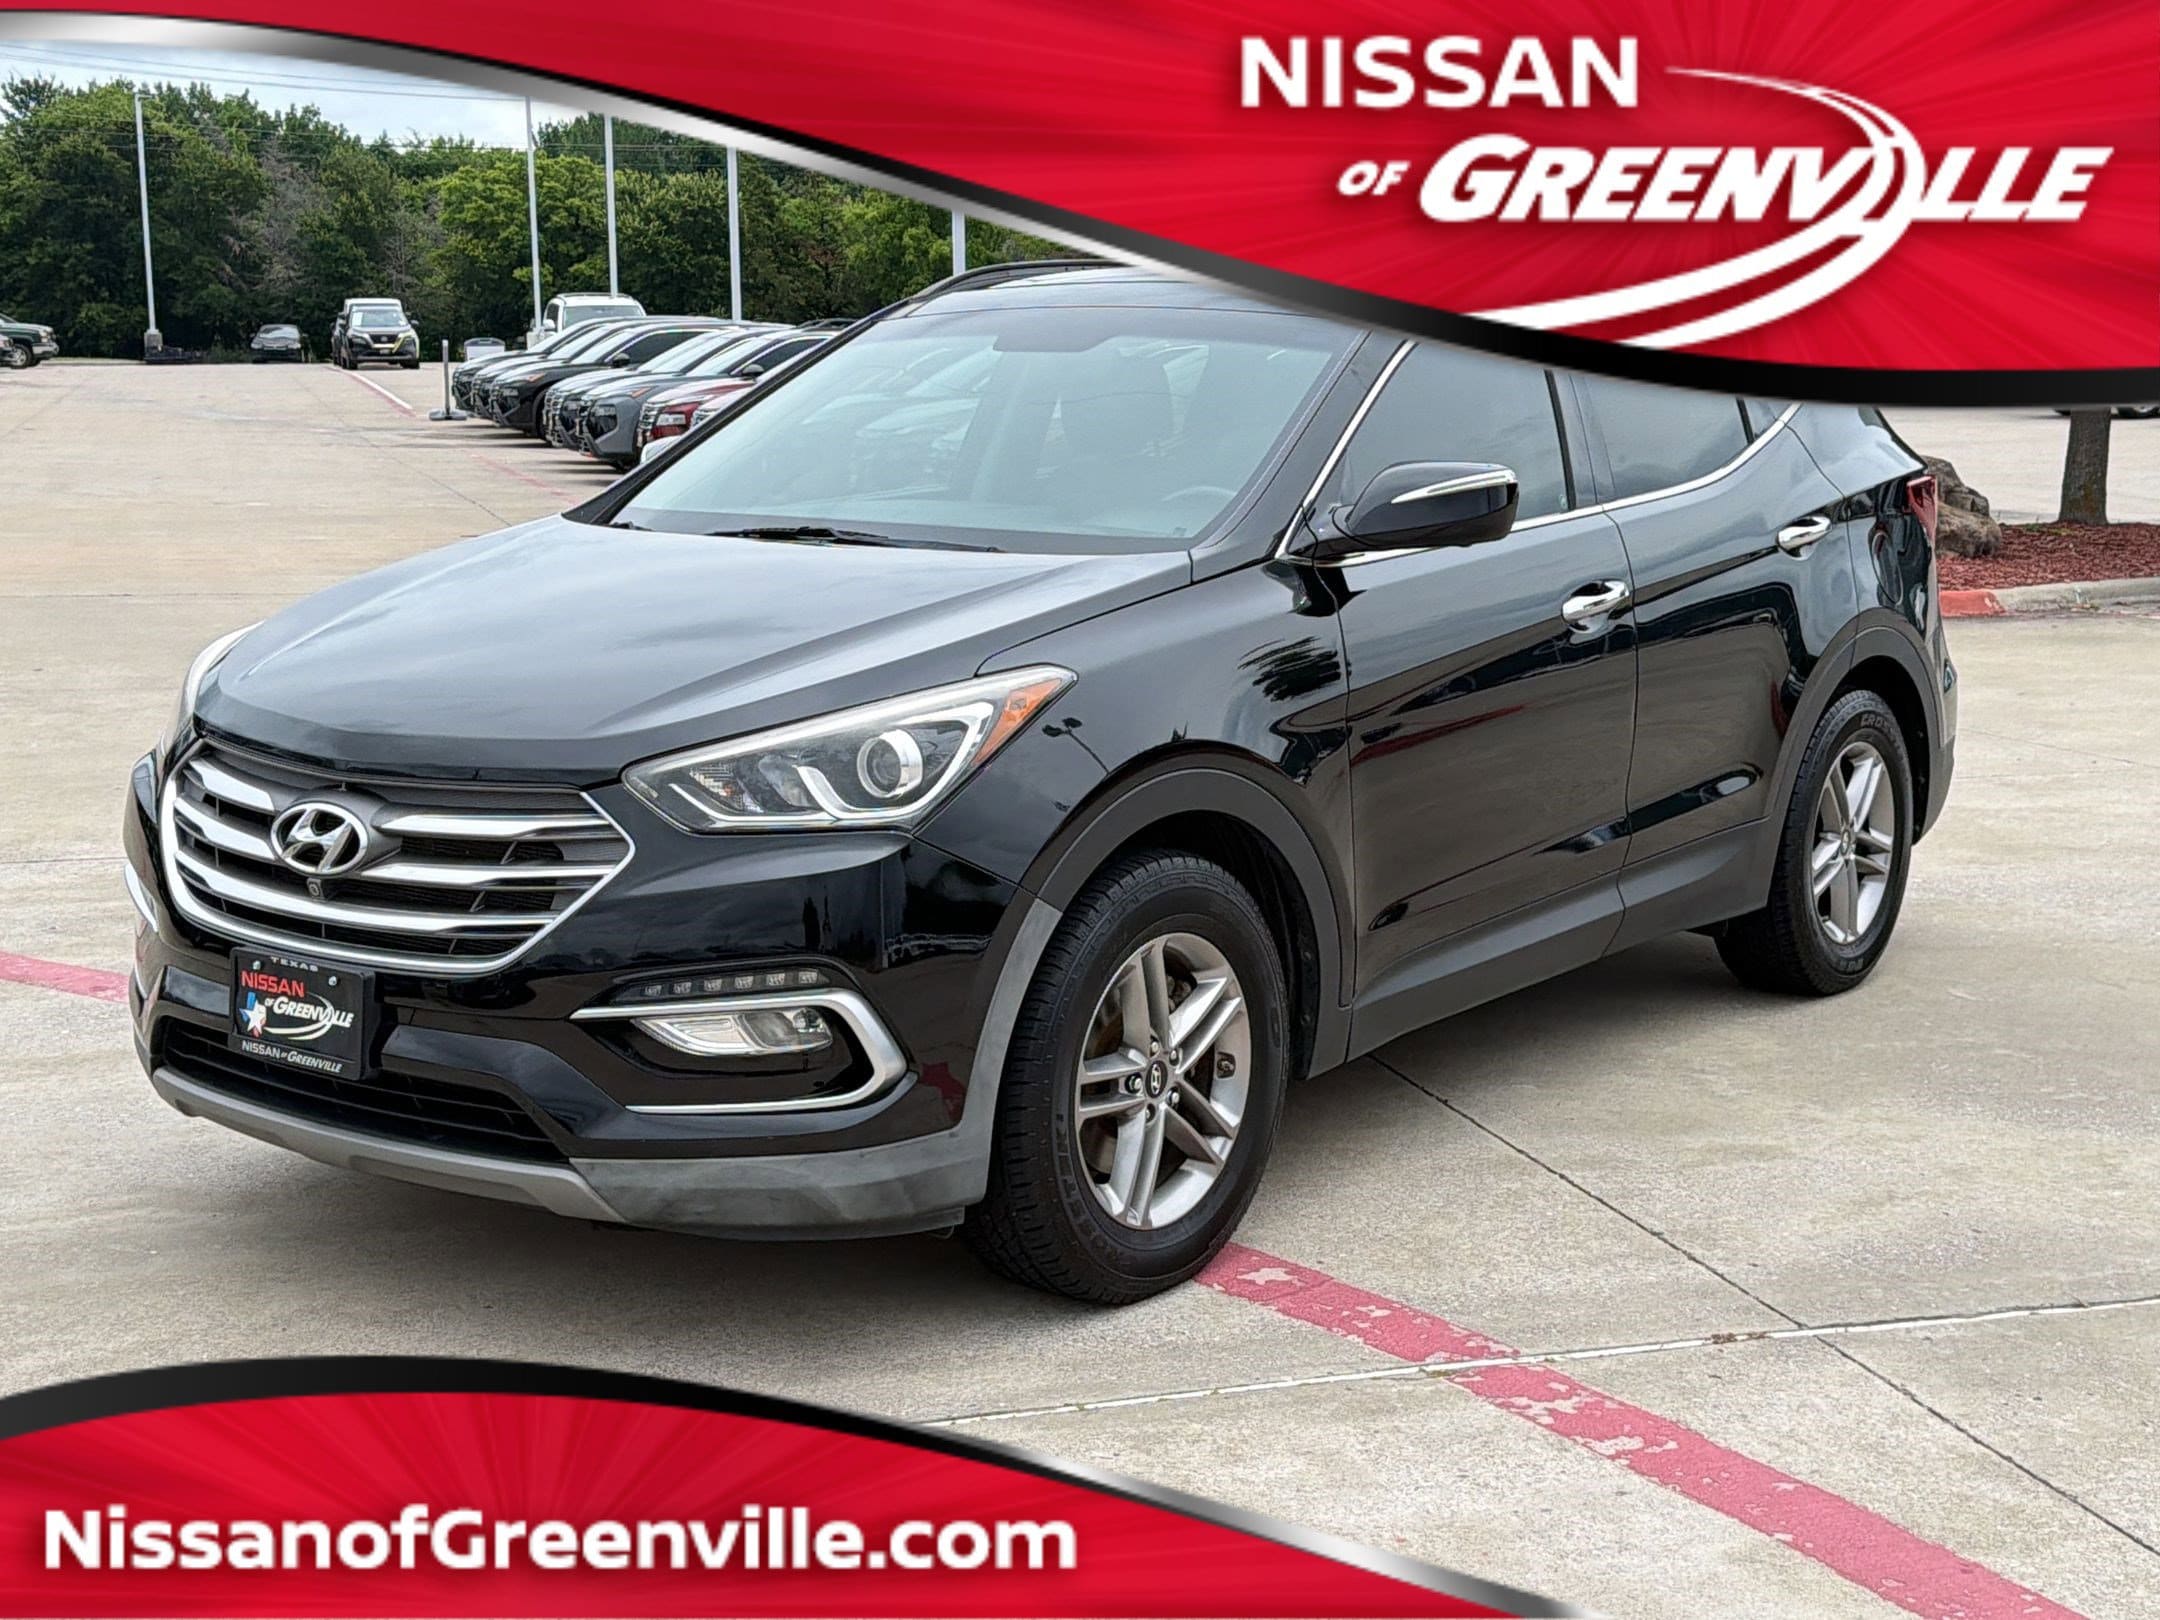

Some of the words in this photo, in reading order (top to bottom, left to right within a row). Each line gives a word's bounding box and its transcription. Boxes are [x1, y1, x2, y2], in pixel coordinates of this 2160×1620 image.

[270, 956, 319, 972] TEXAS
[241, 970, 305, 998] NISSAN
[273, 996, 355, 1028] GREENVILLE
[241, 1040, 281, 1059] NISSAN
[287, 1050, 343, 1073] GREENVILLE
